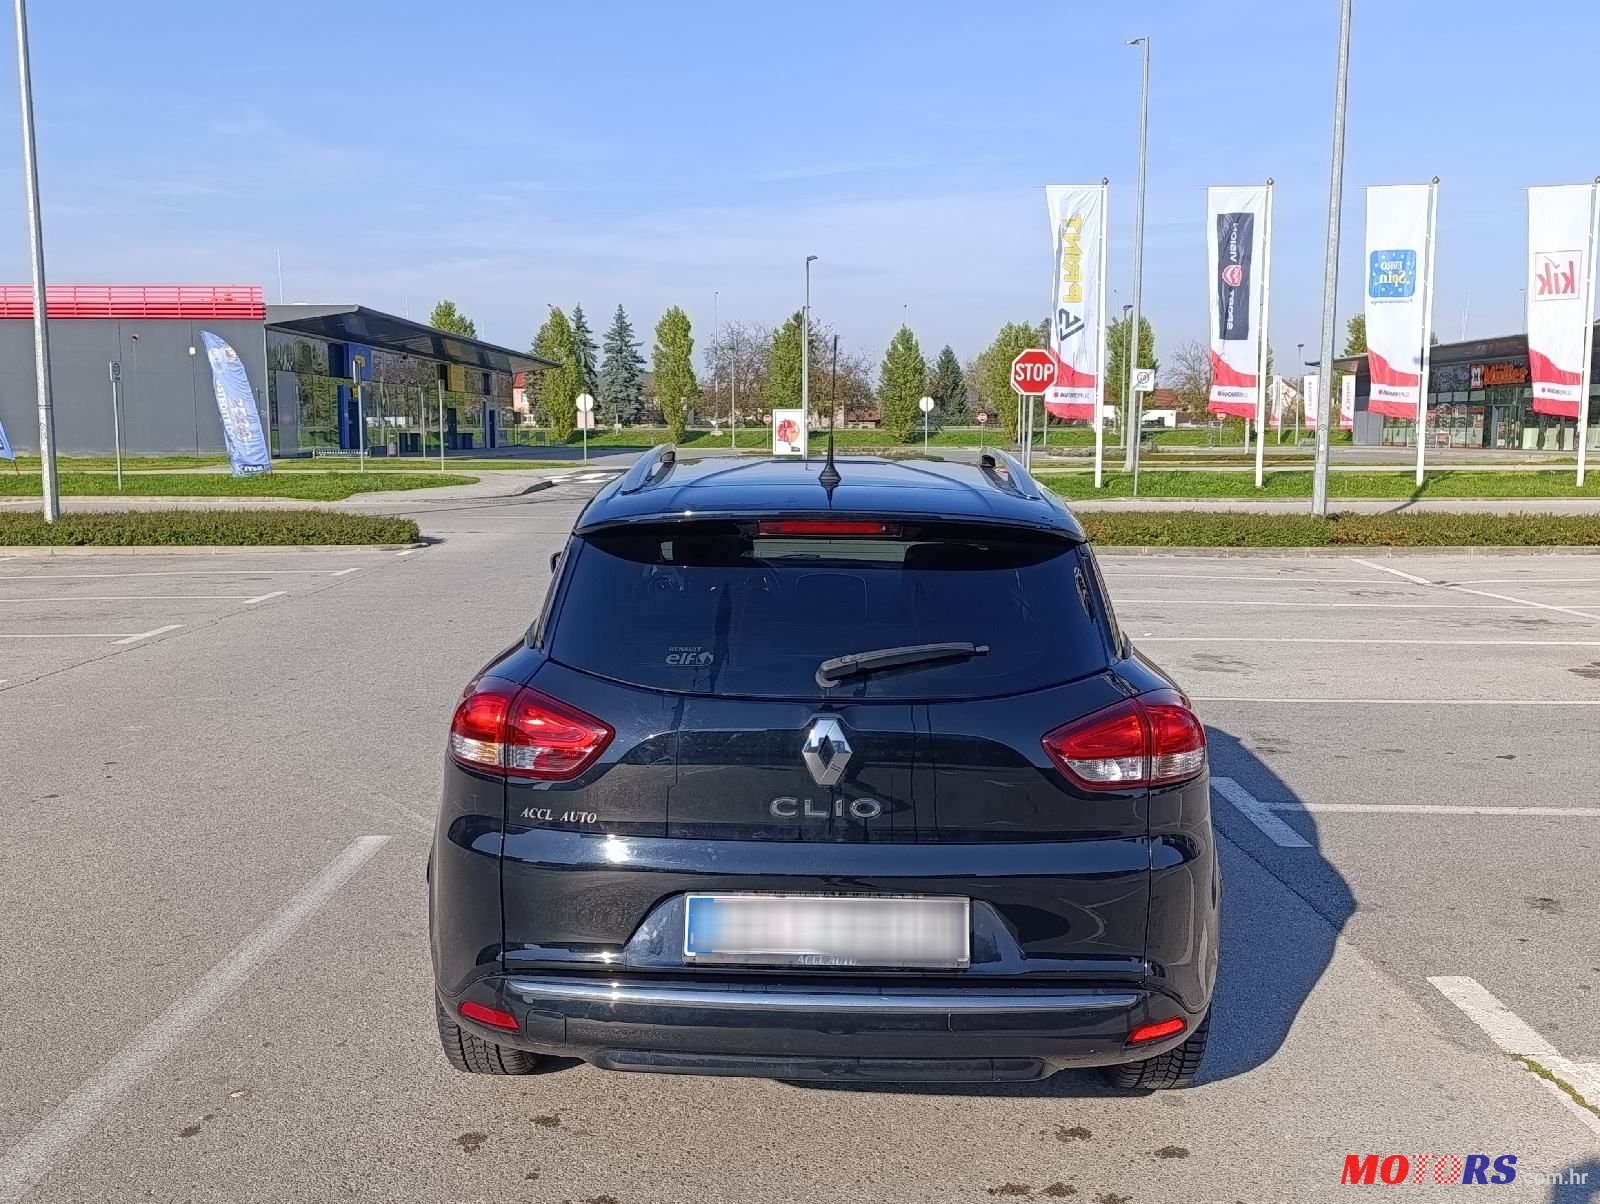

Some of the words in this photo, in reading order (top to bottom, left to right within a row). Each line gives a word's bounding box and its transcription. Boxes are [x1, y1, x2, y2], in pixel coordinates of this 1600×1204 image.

[1014, 362, 1055, 382] STOP
[1484, 364, 1528, 385] Müller
[665, 652, 697, 665] elf
[520, 807, 553, 821] ACCL
[560, 811, 597, 825] AUTO
[769, 797, 882, 819] CLIO
[797, 955, 825, 965] ACCL
